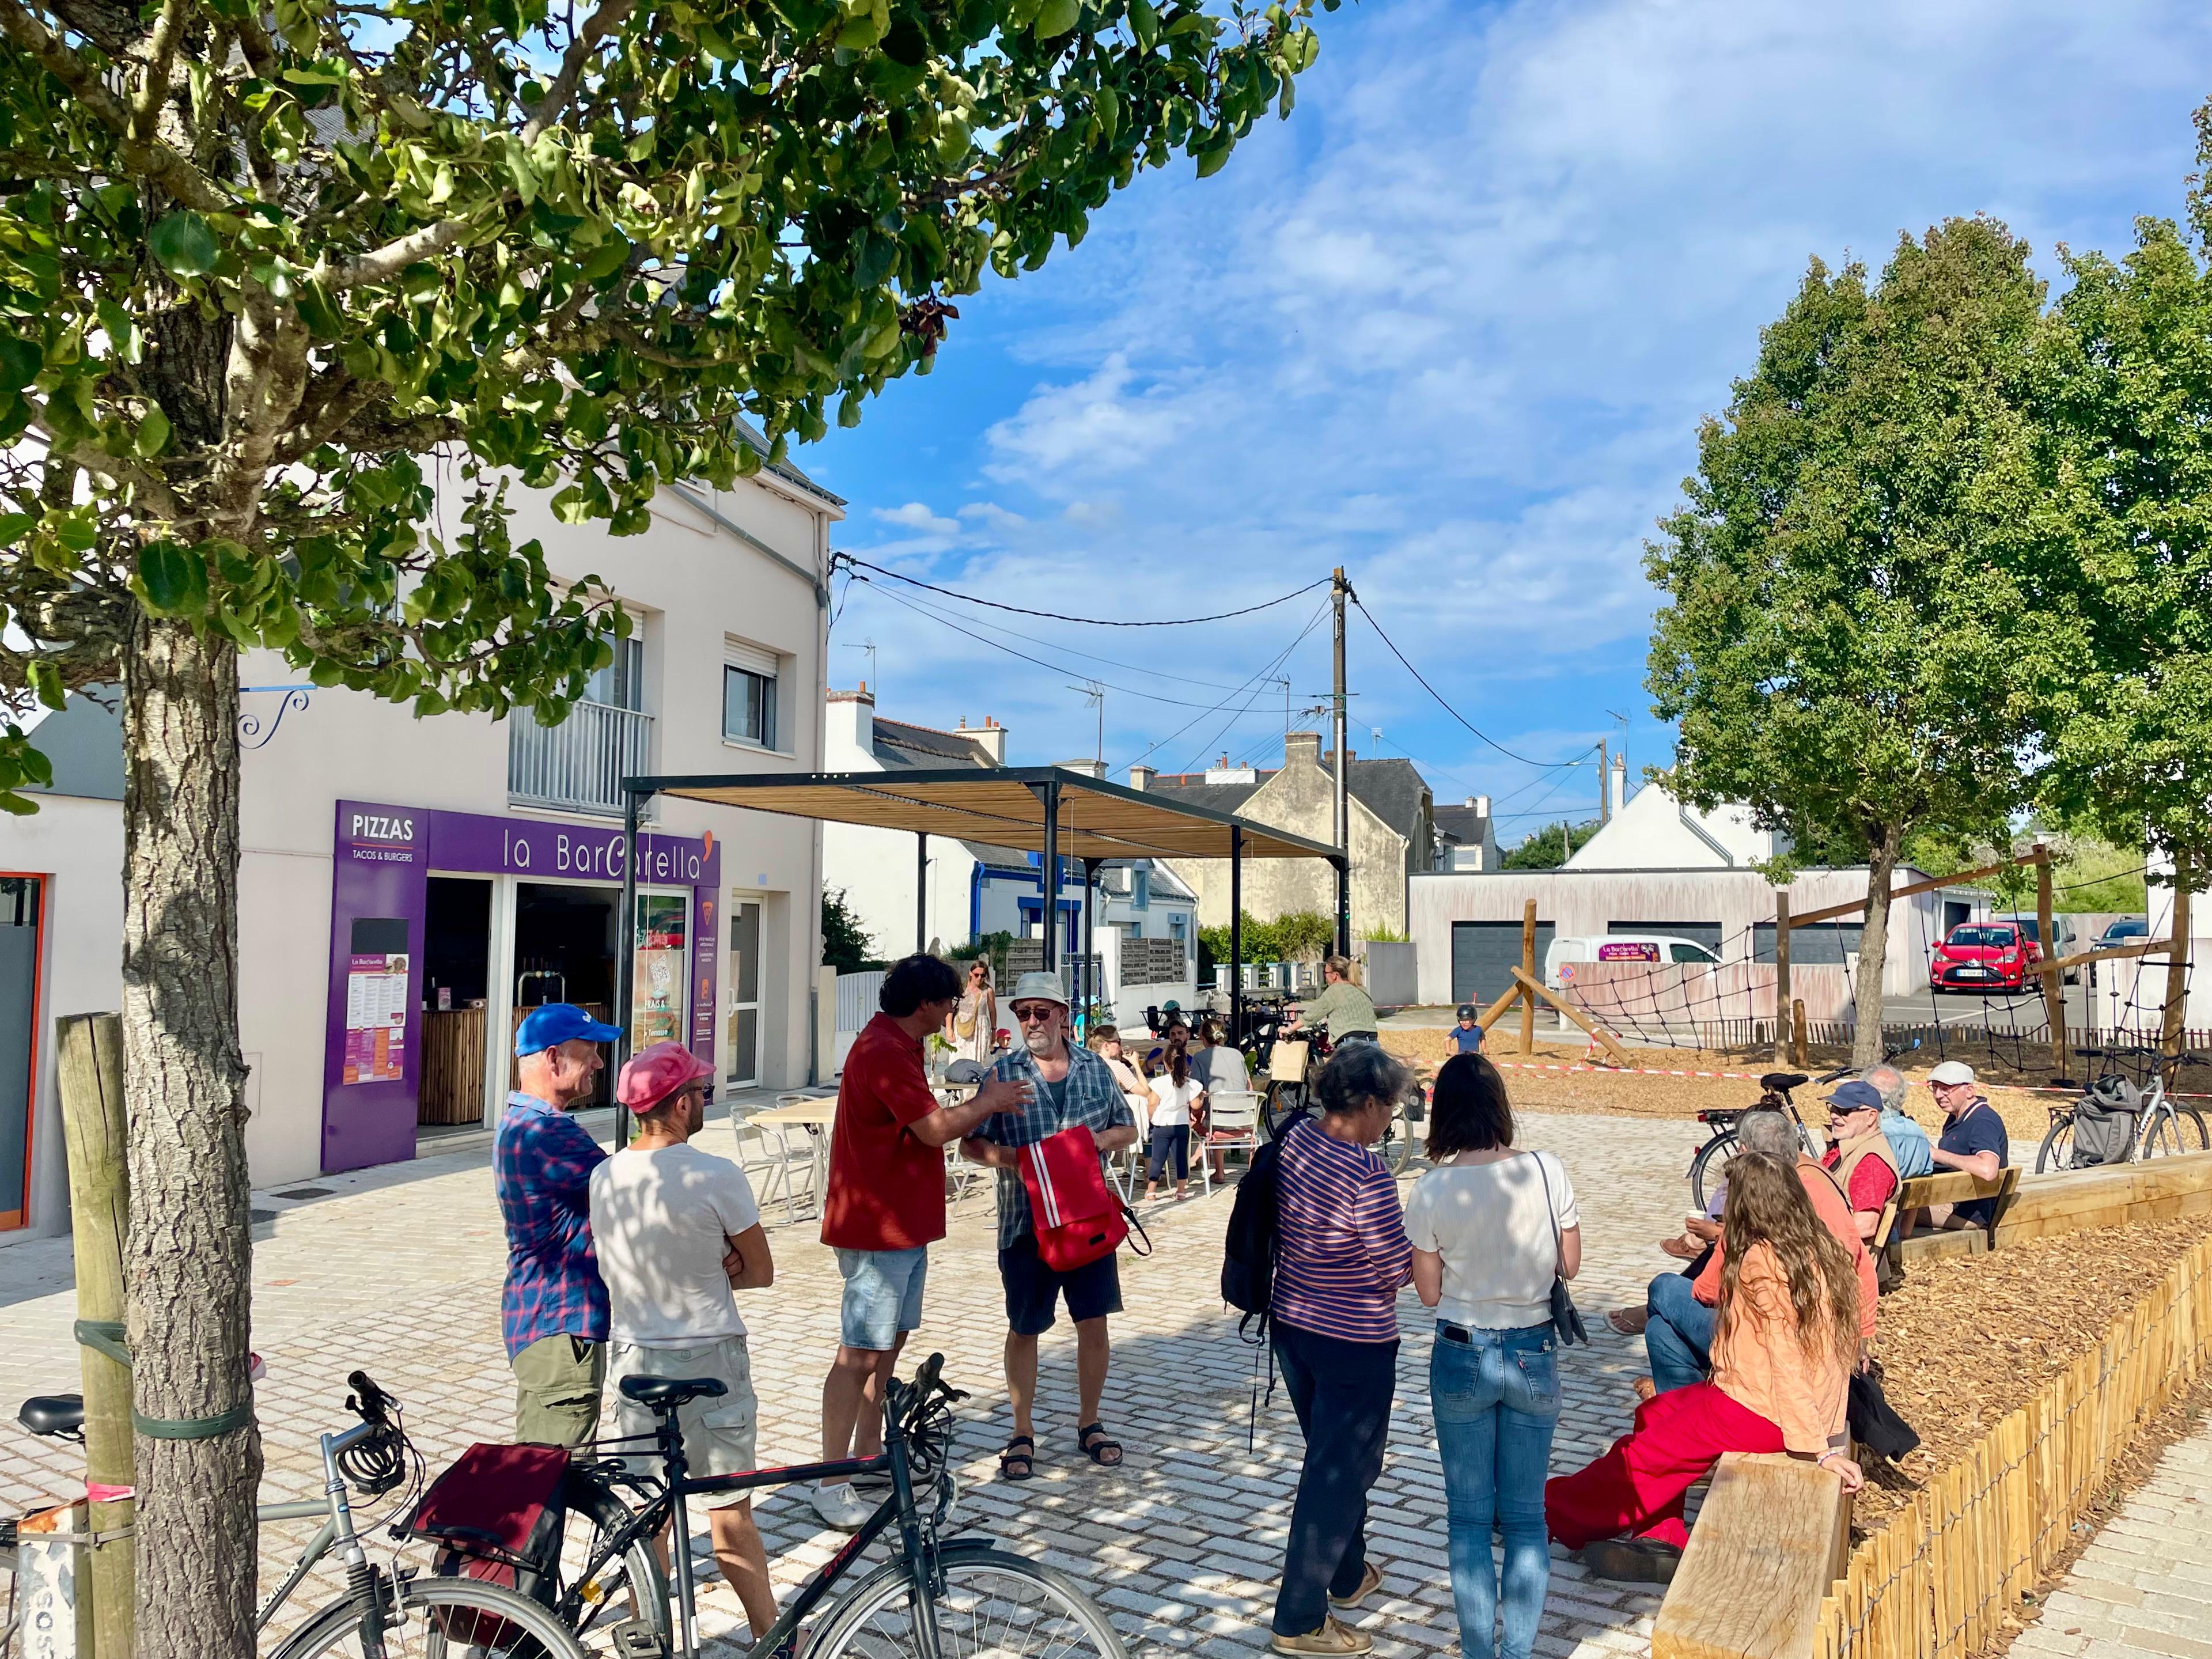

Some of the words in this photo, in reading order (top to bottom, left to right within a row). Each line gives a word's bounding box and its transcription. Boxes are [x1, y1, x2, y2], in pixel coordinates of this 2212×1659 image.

[352, 814, 413, 841] PIZZAS
[353, 849, 377, 860] TACOS
[377, 853, 383, 861] &
[384, 851, 413, 863] BURGERS
[503, 828, 530, 868] la
[645, 999, 660, 1009] FRAIS
[661, 999, 665, 1008] &
